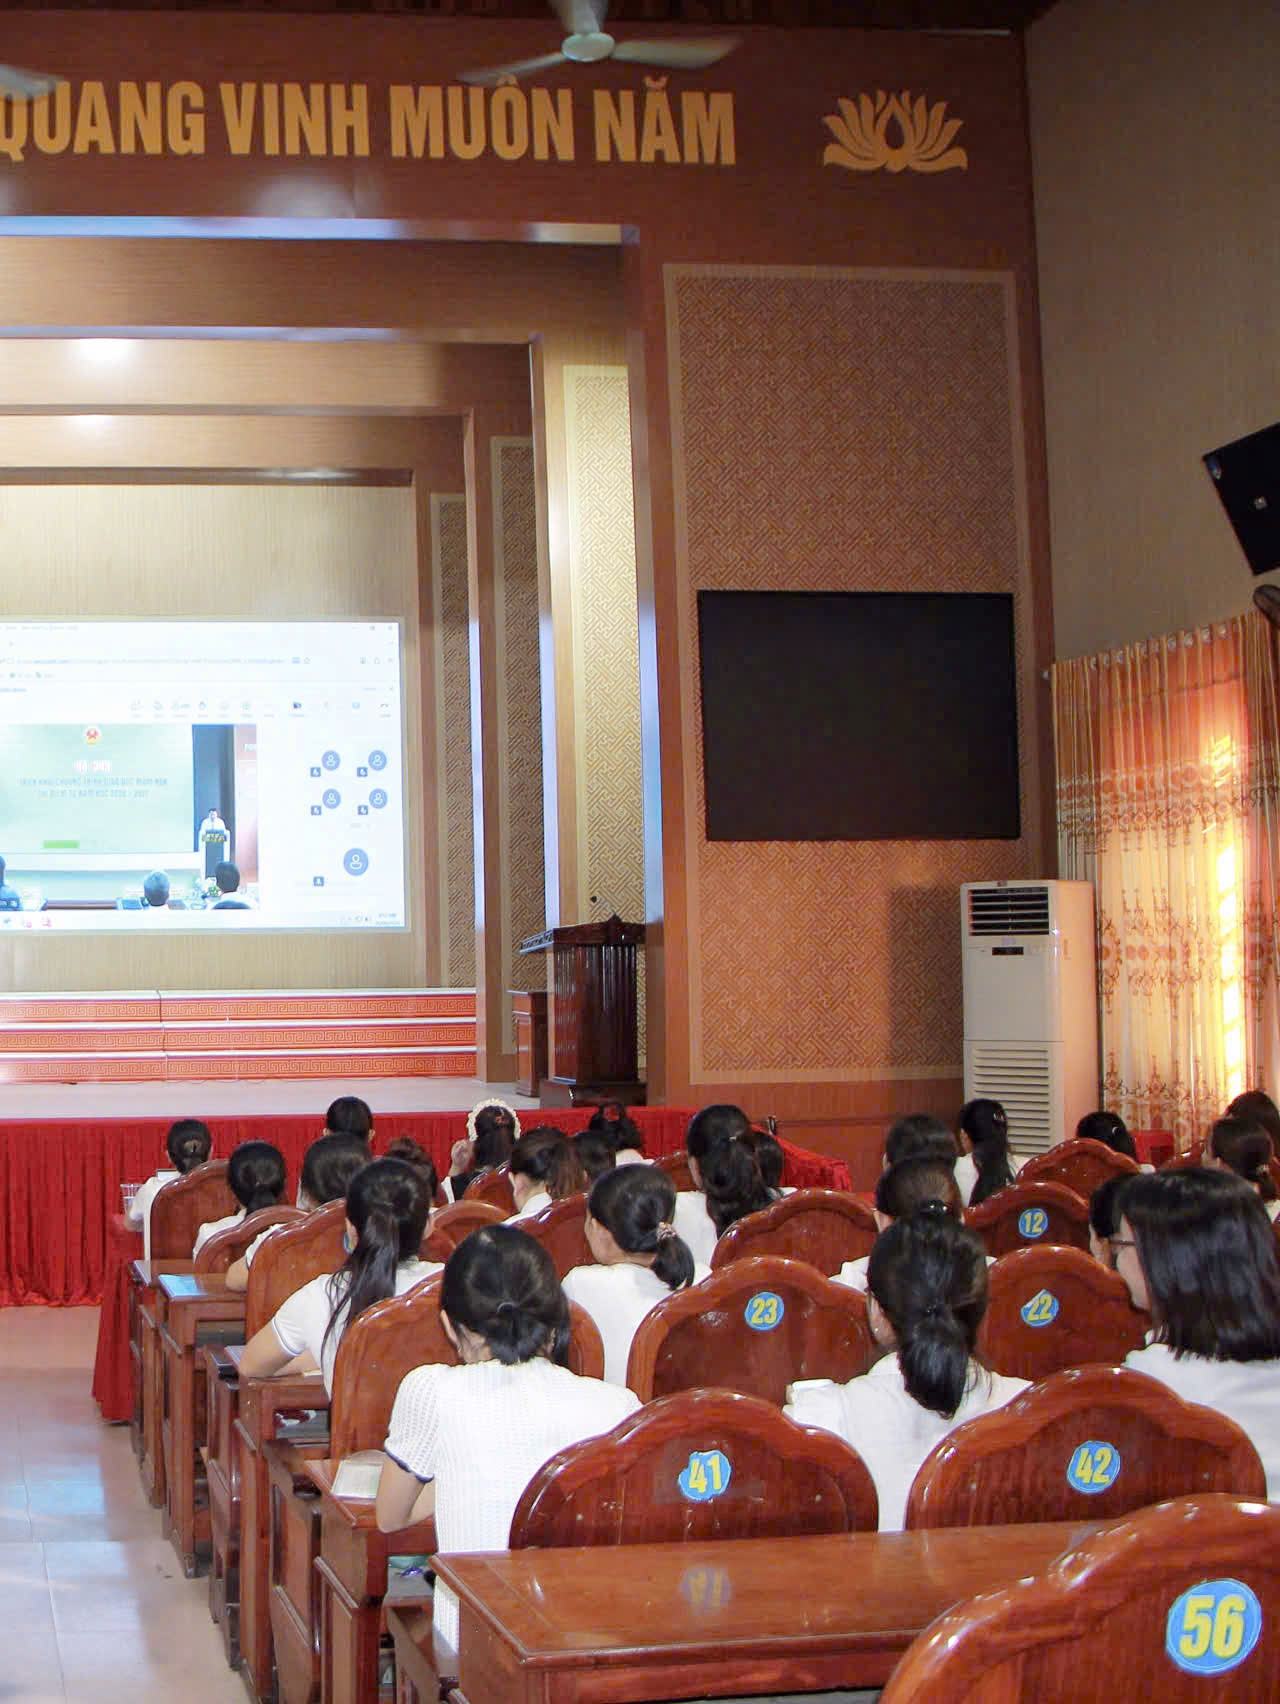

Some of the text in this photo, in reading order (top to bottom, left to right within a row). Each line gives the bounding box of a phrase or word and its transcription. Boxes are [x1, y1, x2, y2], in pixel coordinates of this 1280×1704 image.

[219, 82, 371, 157] VINH
[389, 74, 576, 161] MUÔN
[593, 75, 737, 165] NĂM
[1025, 1212, 1045, 1233] 12
[751, 1298, 778, 1324] 23
[1028, 1296, 1052, 1322] 22
[689, 1457, 722, 1494] 41
[1075, 1448, 1112, 1484] 42
[1180, 1596, 1246, 1659] 56
